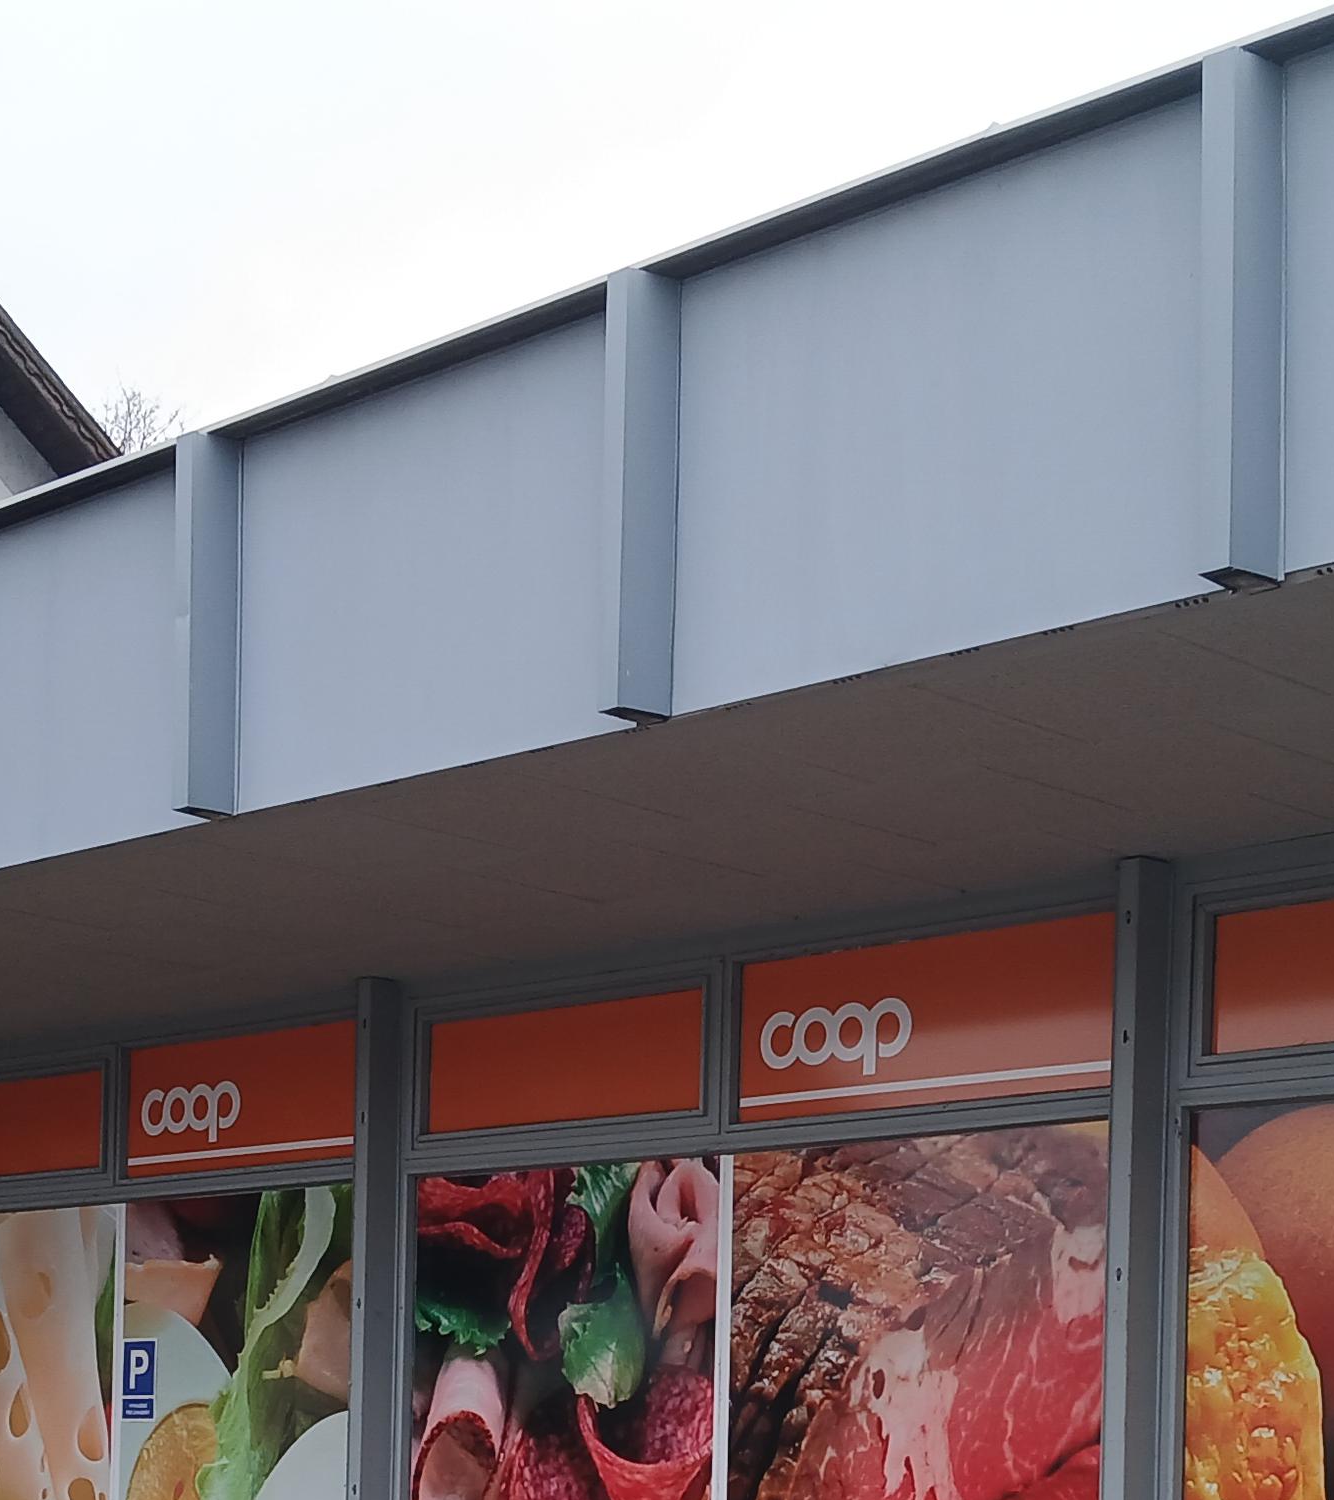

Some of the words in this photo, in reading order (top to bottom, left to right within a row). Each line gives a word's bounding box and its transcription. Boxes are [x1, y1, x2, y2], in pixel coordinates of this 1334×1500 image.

[760, 997, 912, 1076] coop
[141, 1080, 241, 1143] coop
[129, 1349, 149, 1390] P
